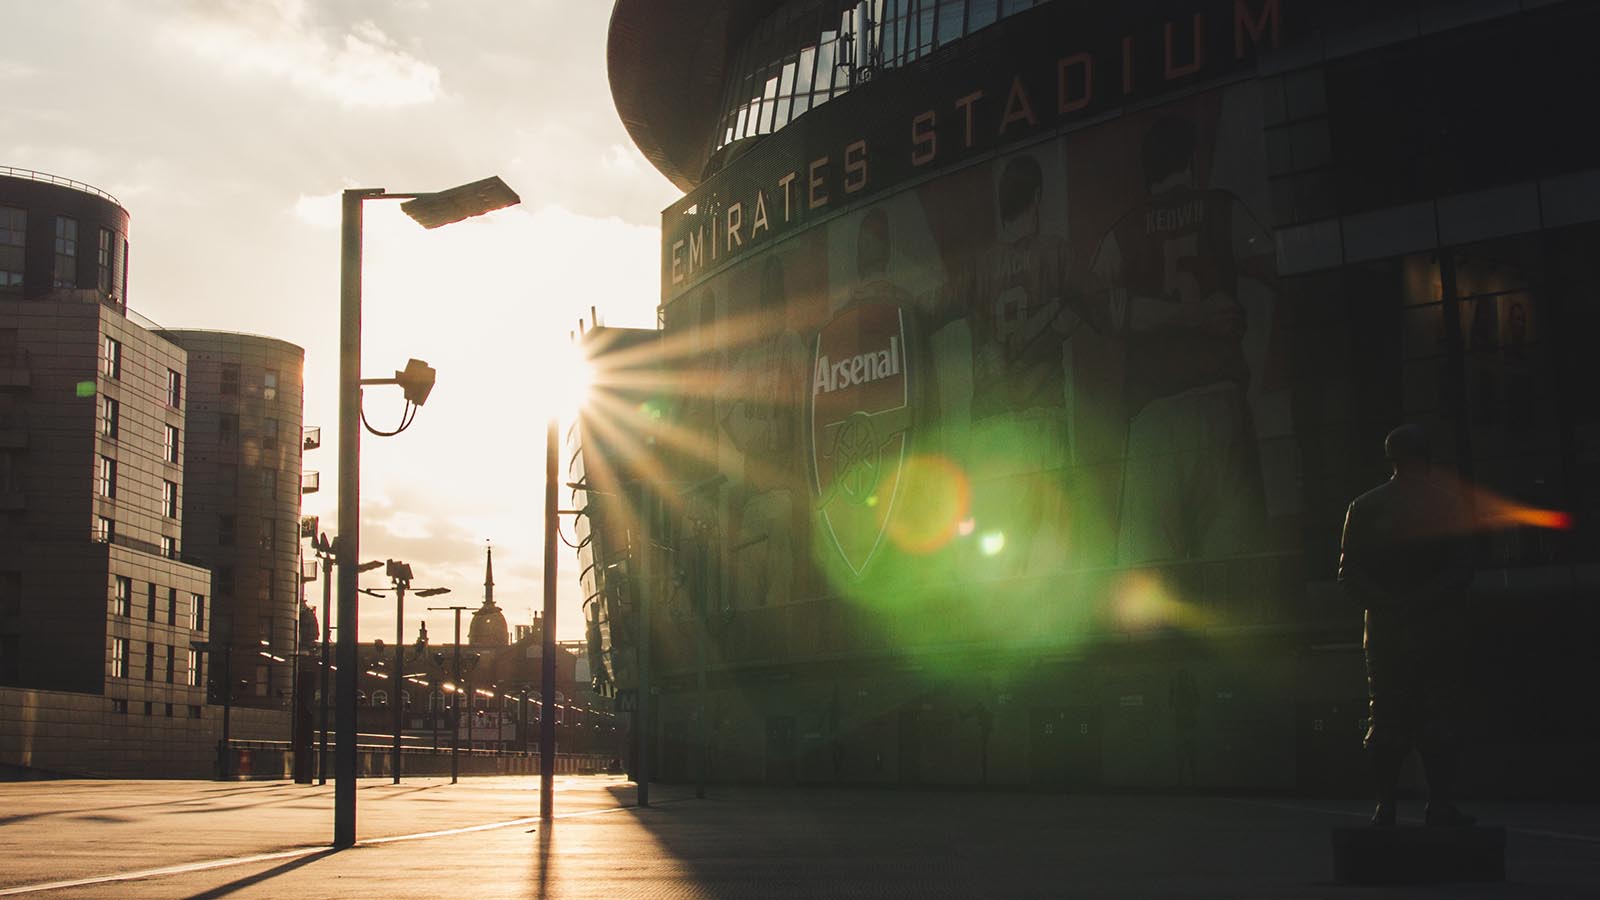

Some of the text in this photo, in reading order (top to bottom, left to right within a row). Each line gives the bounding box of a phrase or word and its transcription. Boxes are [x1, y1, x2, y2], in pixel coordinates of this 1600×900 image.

[671, 0, 1281, 286] EMIRATES STADIUM
[815, 336, 900, 393] Arsenal
